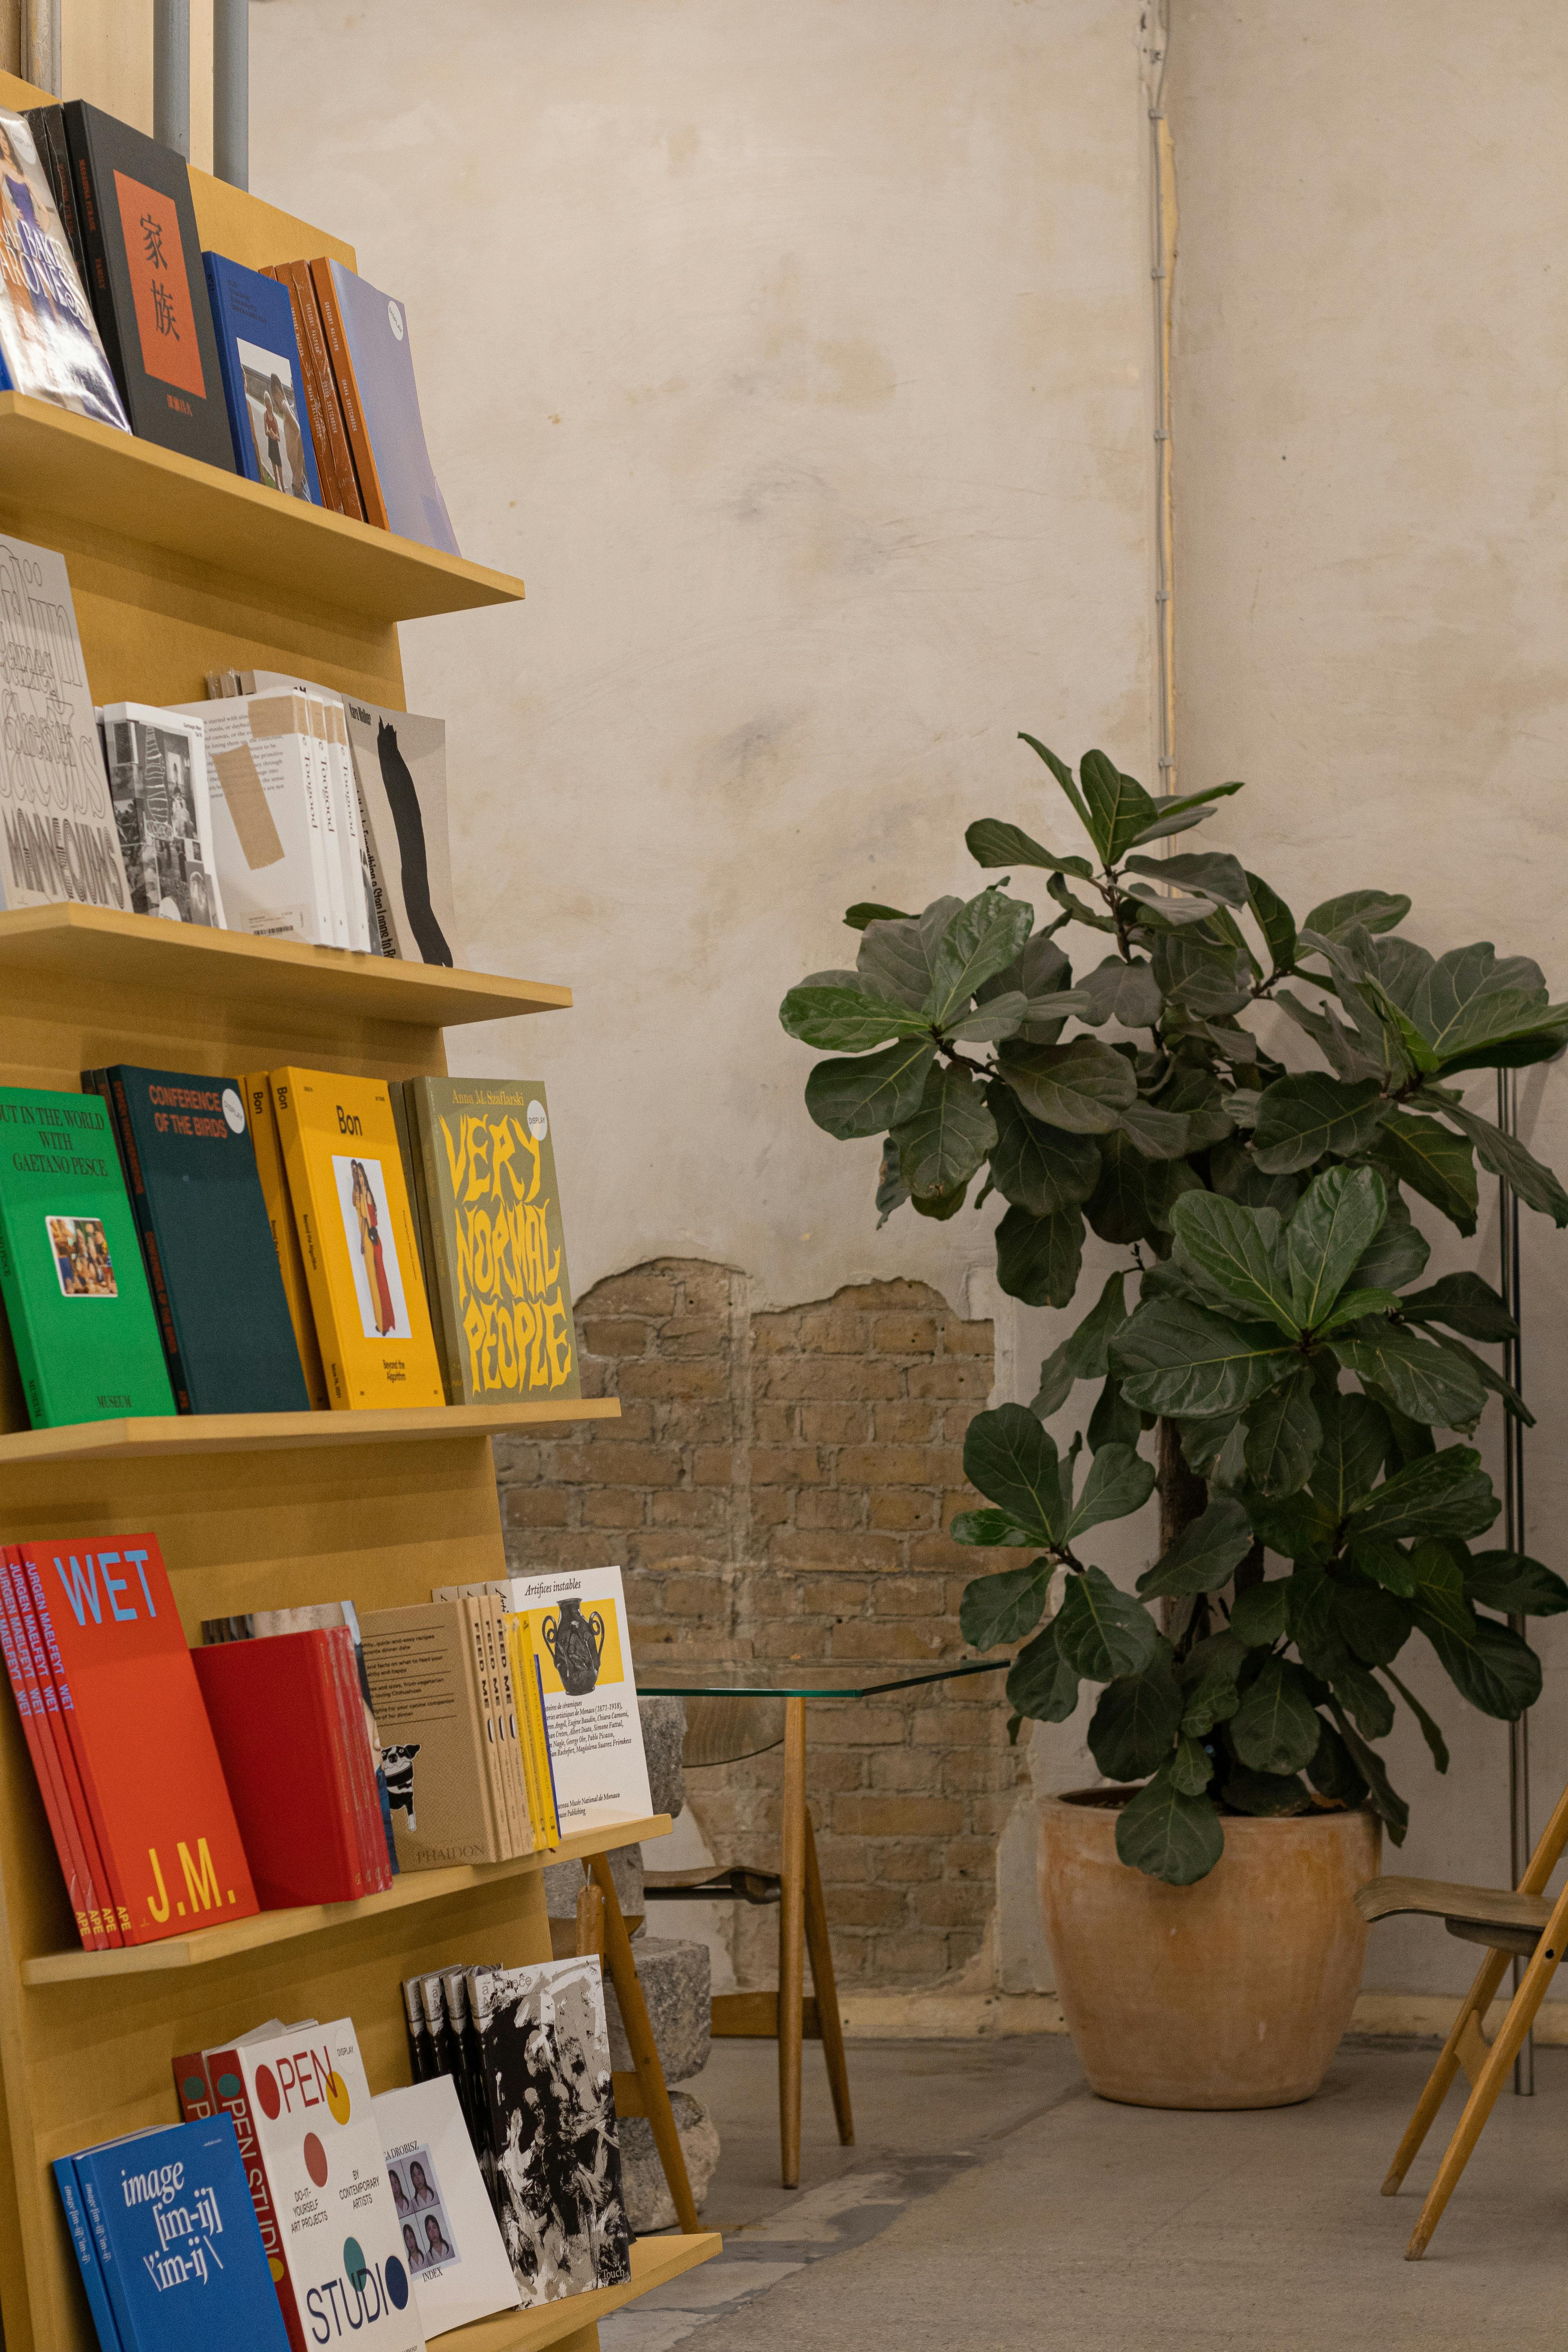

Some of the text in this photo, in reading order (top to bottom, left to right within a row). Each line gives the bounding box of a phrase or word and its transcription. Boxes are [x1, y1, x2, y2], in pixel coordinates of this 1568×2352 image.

[140, 213, 180, 341] 家族
[388, 307, 403, 334] DISPLAY
[325, 301, 333, 325] GREGORY
[330, 328, 339, 351] HALPERN
[346, 399, 357, 432] SKETCHBOOK
[312, 330, 320, 354] HALPERN
[327, 401, 337, 433] SKETCHBOOK
[348, 702, 371, 726] Kara Walker
[305, 753, 318, 828] Toogood
[321, 757, 334, 832] Toogood
[343, 762, 355, 837] Toogood
[149, 1085, 223, 1112] CONFERENCE
[253, 1092, 263, 1114] Bon
[277, 1087, 288, 1109] Bon
[452, 1089, 524, 1106] Anna M. Szaflarski
[20, 1106, 35, 1124] IN
[35, 1107, 64, 1126] THE
[63, 1110, 105, 1130] WORLD
[154, 1112, 227, 1138] OF THE BIRDS
[336, 1105, 362, 1136] Bon
[528, 1116, 545, 1125] DISPLAY
[38, 1131, 74, 1151] WITH
[13, 1154, 108, 1176] GAETANO PESCE
[438, 1113, 540, 1203] VERY
[454, 1198, 560, 1310] NORMAL
[464, 1286, 571, 1396] PEOPLE
[96, 1394, 132, 1409] MUSEUM
[54, 1550, 156, 1626] WET
[524, 1578, 581, 1598] Artifices instables
[9, 1563, 59, 1712] JURGEN MAELFEYT WET
[25, 1561, 74, 1710] JURGEN MAELFEYT WET
[10, 1617, 45, 1715] MAELFEYT WET
[475, 1622, 489, 1709] FEED ME
[486, 1621, 500, 1706] FEED ME
[497, 1619, 512, 1704] FEED ME
[16, 1690, 31, 1717] WET
[556, 1711, 574, 1719] artistiques
[595, 1702, 622, 1715] (1871-1918),
[562, 1701, 582, 1710] céramiques
[569, 1728, 581, 1736] Albert
[581, 1726, 593, 1734] Diato,
[609, 1720, 624, 1729] Fattal,
[581, 1716, 597, 1724] Baudin,
[612, 1710, 629, 1719] Camoni,
[553, 1741, 566, 1749] Nagle,
[566, 1738, 578, 1746] George
[599, 1731, 615, 1740] Picasso,
[557, 1748, 575, 1757] Rochefort,
[576, 1744, 597, 1754] Magdalena
[613, 1738, 632, 1746] Frimkess
[567, 1808, 586, 1817] Publishing
[570, 1798, 581, 1807] Musée
[582, 1794, 598, 1805] National
[417, 1844, 485, 1862] PHAIDON
[147, 1838, 236, 1922] J.M.
[76, 1911, 91, 1936] APE
[88, 1909, 104, 1935] APE
[102, 1907, 116, 1933] APE
[116, 1906, 131, 1931] APE
[482, 1985, 489, 1995] a
[493, 1976, 532, 1993] Dance
[337, 2046, 353, 2057] DISPLAY
[391, 2140, 419, 2158] DROBISZ
[121, 2161, 184, 2207] image
[352, 2169, 359, 2180] BY
[294, 2188, 311, 2202] DO-IT-
[339, 2176, 379, 2200] CONTEMPORARY
[293, 2199, 318, 2217] YOURSELF
[353, 2194, 372, 2210] ARTISTS
[291, 2210, 328, 2234] ART PROJECTS
[423, 2266, 443, 2282] INDEX
[601, 2266, 624, 2280] Touch
